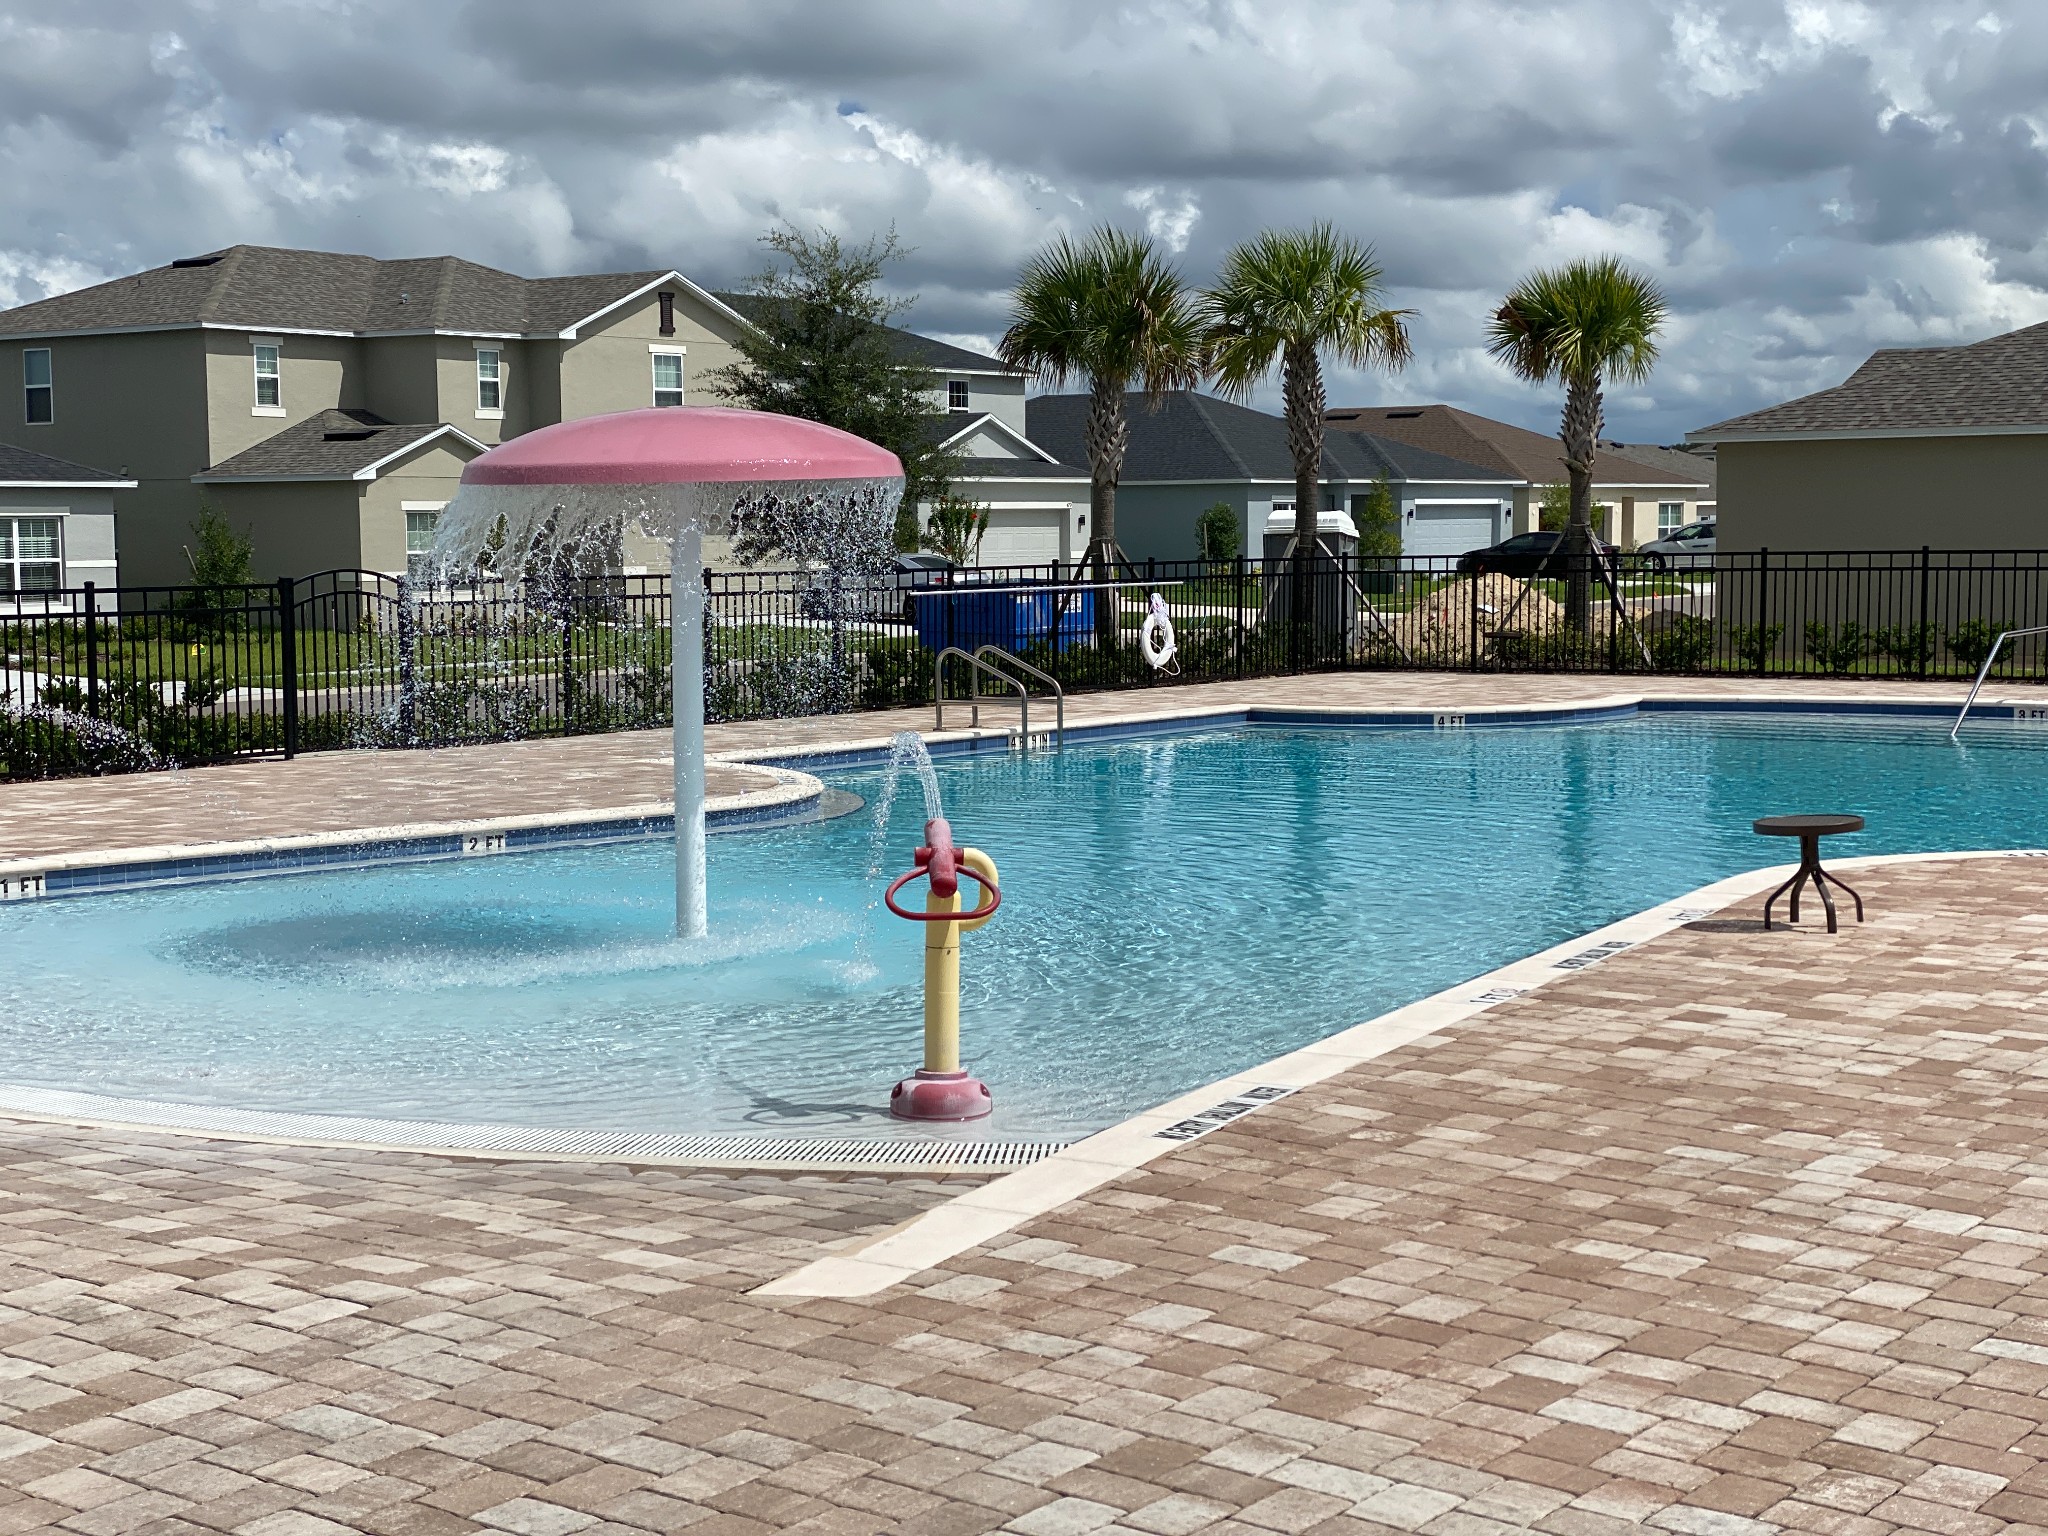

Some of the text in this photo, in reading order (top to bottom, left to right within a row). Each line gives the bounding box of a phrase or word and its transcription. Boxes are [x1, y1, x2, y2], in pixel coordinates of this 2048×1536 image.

[2031, 710, 2046, 719] FT
[1438, 715, 1464, 725] 4 FT
[1011, 736, 1016, 746] 4
[486, 834, 504, 848] FT
[0, 875, 43, 894] 1 FT
